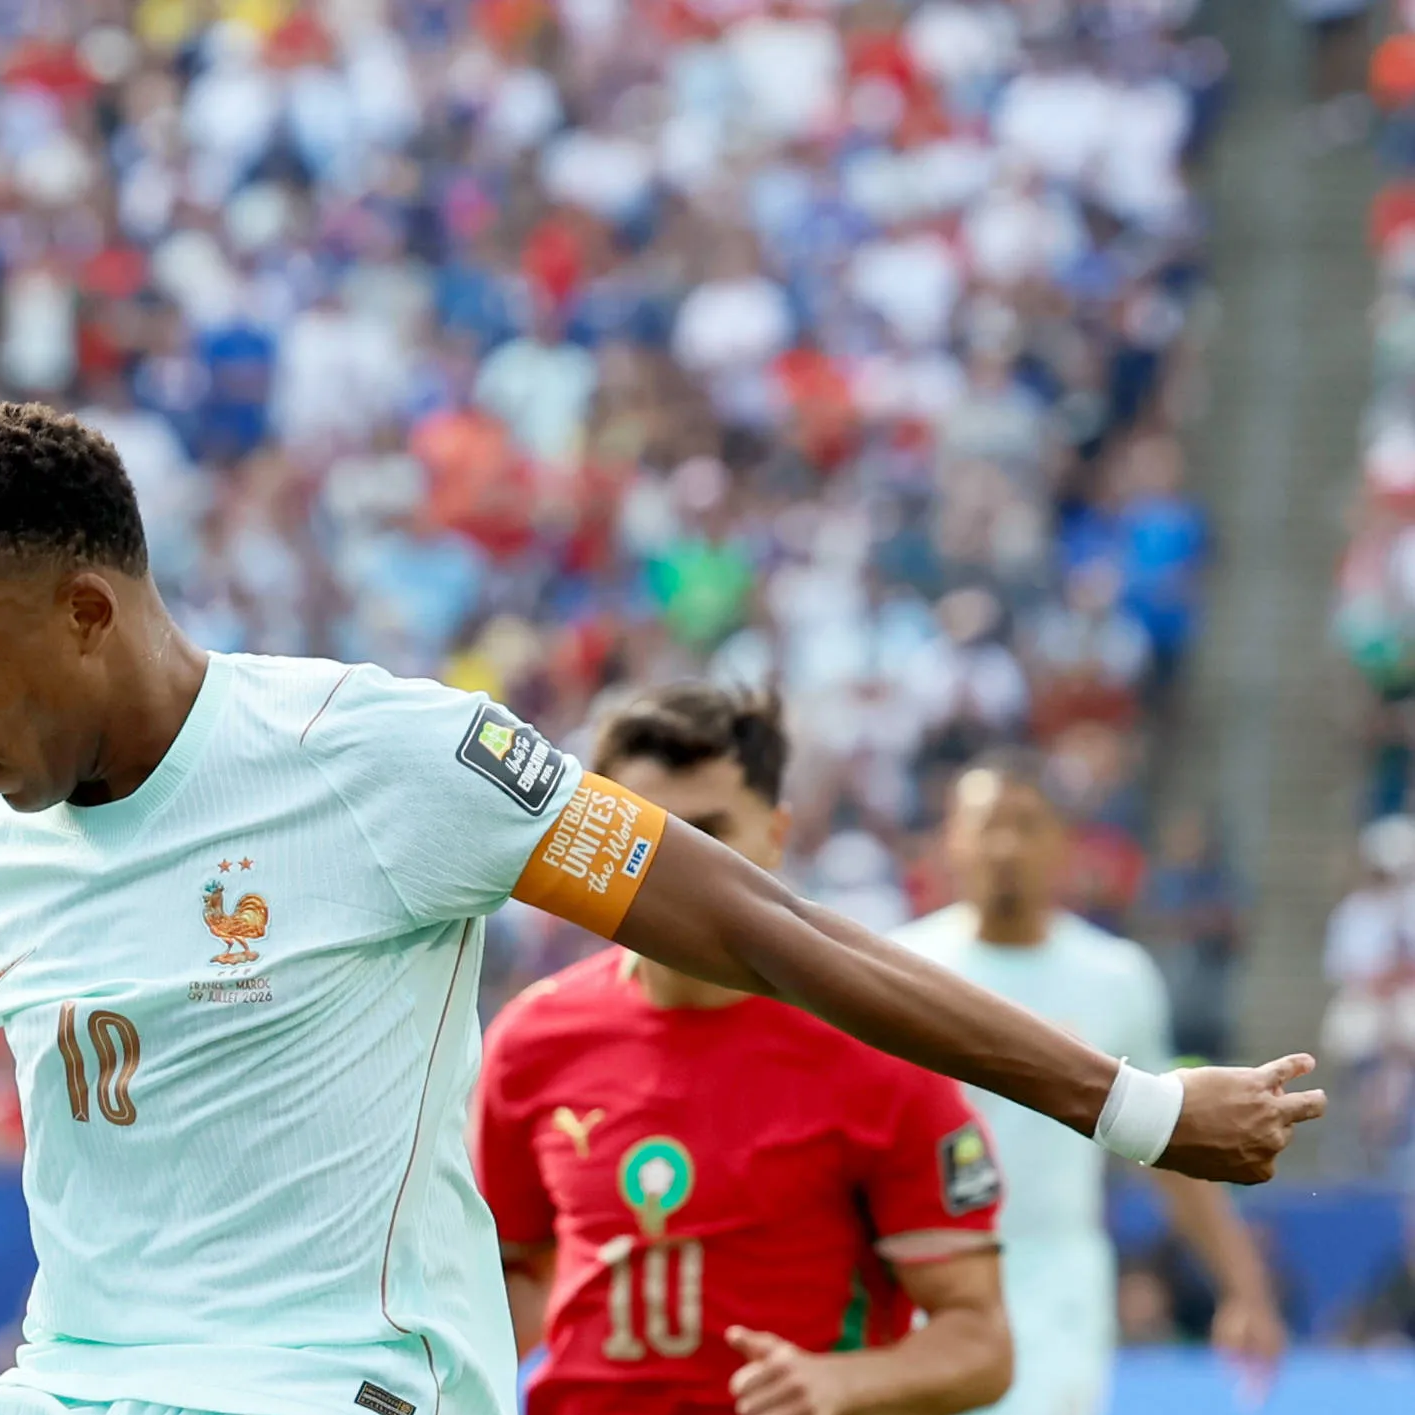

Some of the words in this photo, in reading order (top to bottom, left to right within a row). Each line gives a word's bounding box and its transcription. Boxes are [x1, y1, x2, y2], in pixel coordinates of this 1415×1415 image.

[542, 787, 592, 868] FOOTBALL
[560, 791, 617, 879] UNITES
[587, 861, 615, 894] the
[602, 797, 642, 860] World
[626, 843, 648, 874] FIFA
[187, 991, 203, 1001] 09
[207, 990, 239, 1003] JUILLET
[242, 990, 273, 1004] 2026
[188, 980, 225, 991] FRANCE
[235, 977, 271, 991] MAROC
[57, 1001, 140, 1126] 10
[597, 1234, 704, 1361] 10
